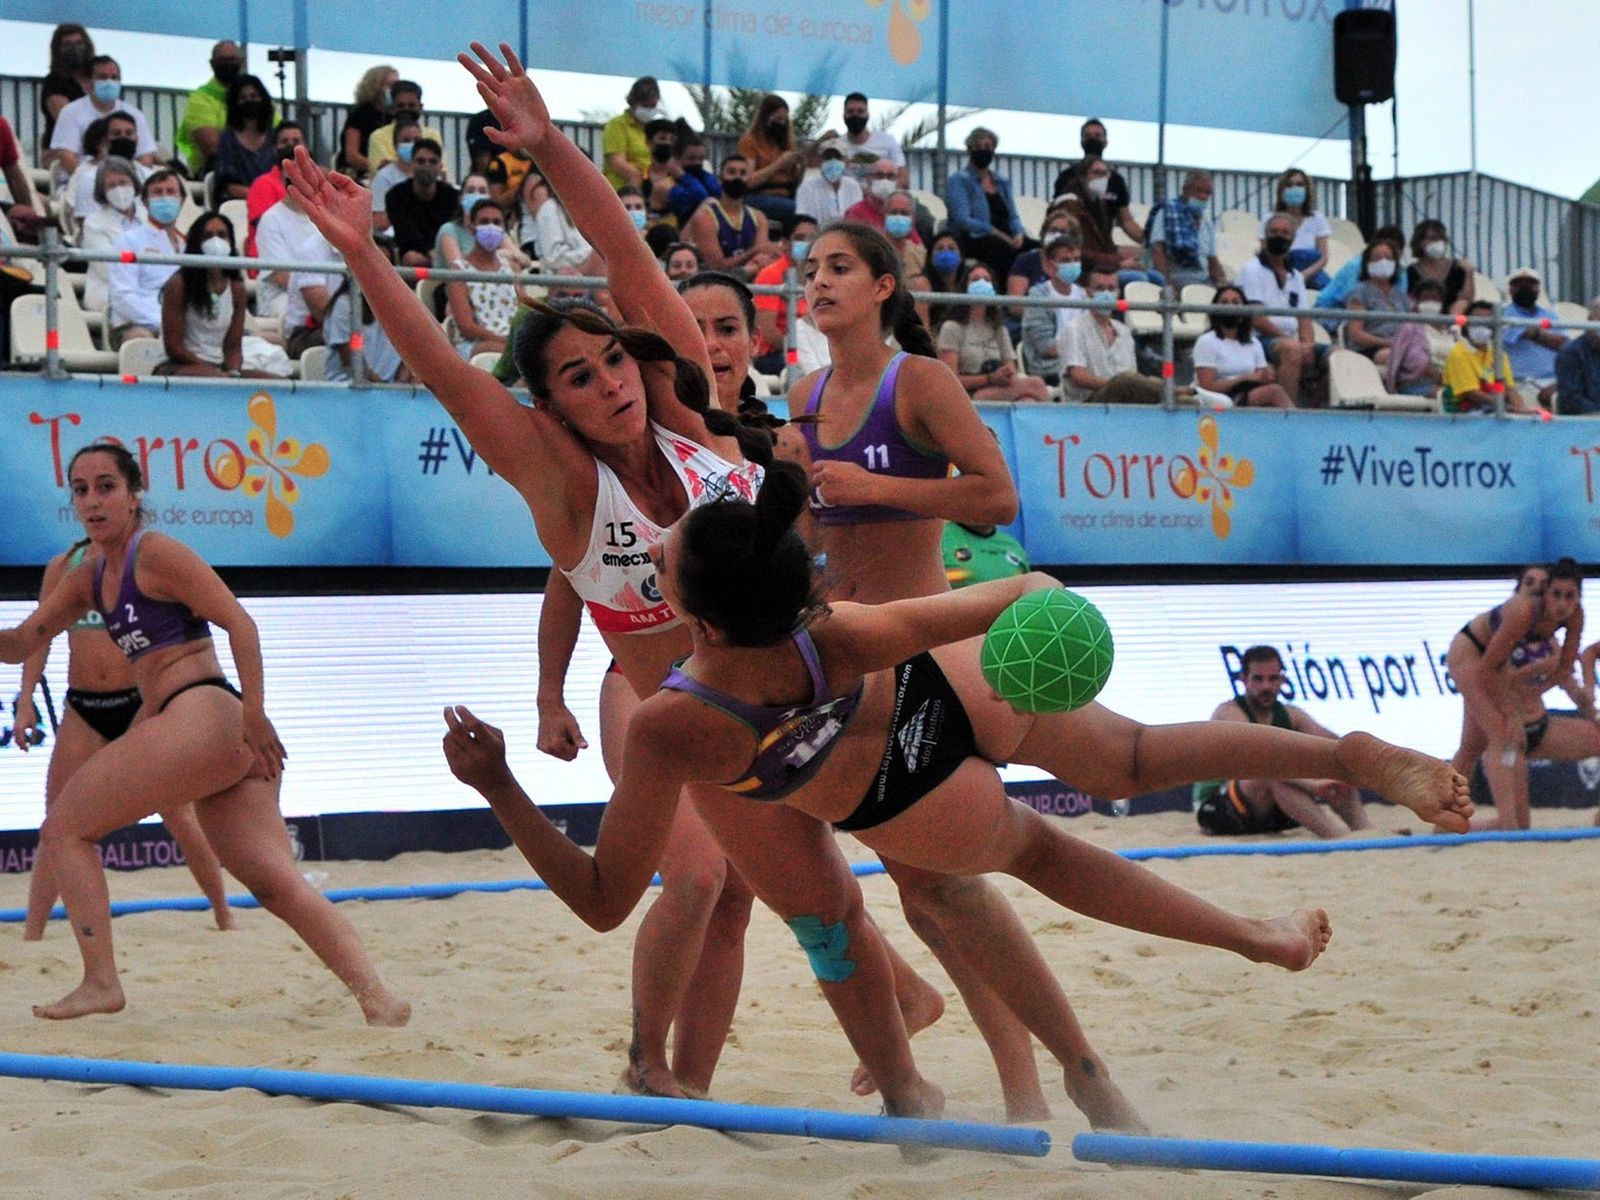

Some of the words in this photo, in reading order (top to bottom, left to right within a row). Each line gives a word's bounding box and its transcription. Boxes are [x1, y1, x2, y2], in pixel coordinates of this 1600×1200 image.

[863, 443, 890, 470] 11
[1320, 444, 1516, 489] #ViveTorrox
[191, 507, 255, 530] europa
[605, 520, 638, 548] 15
[124, 602, 139, 624] 2
[1219, 641, 1354, 701] Psión
[1358, 653, 1420, 714] por
